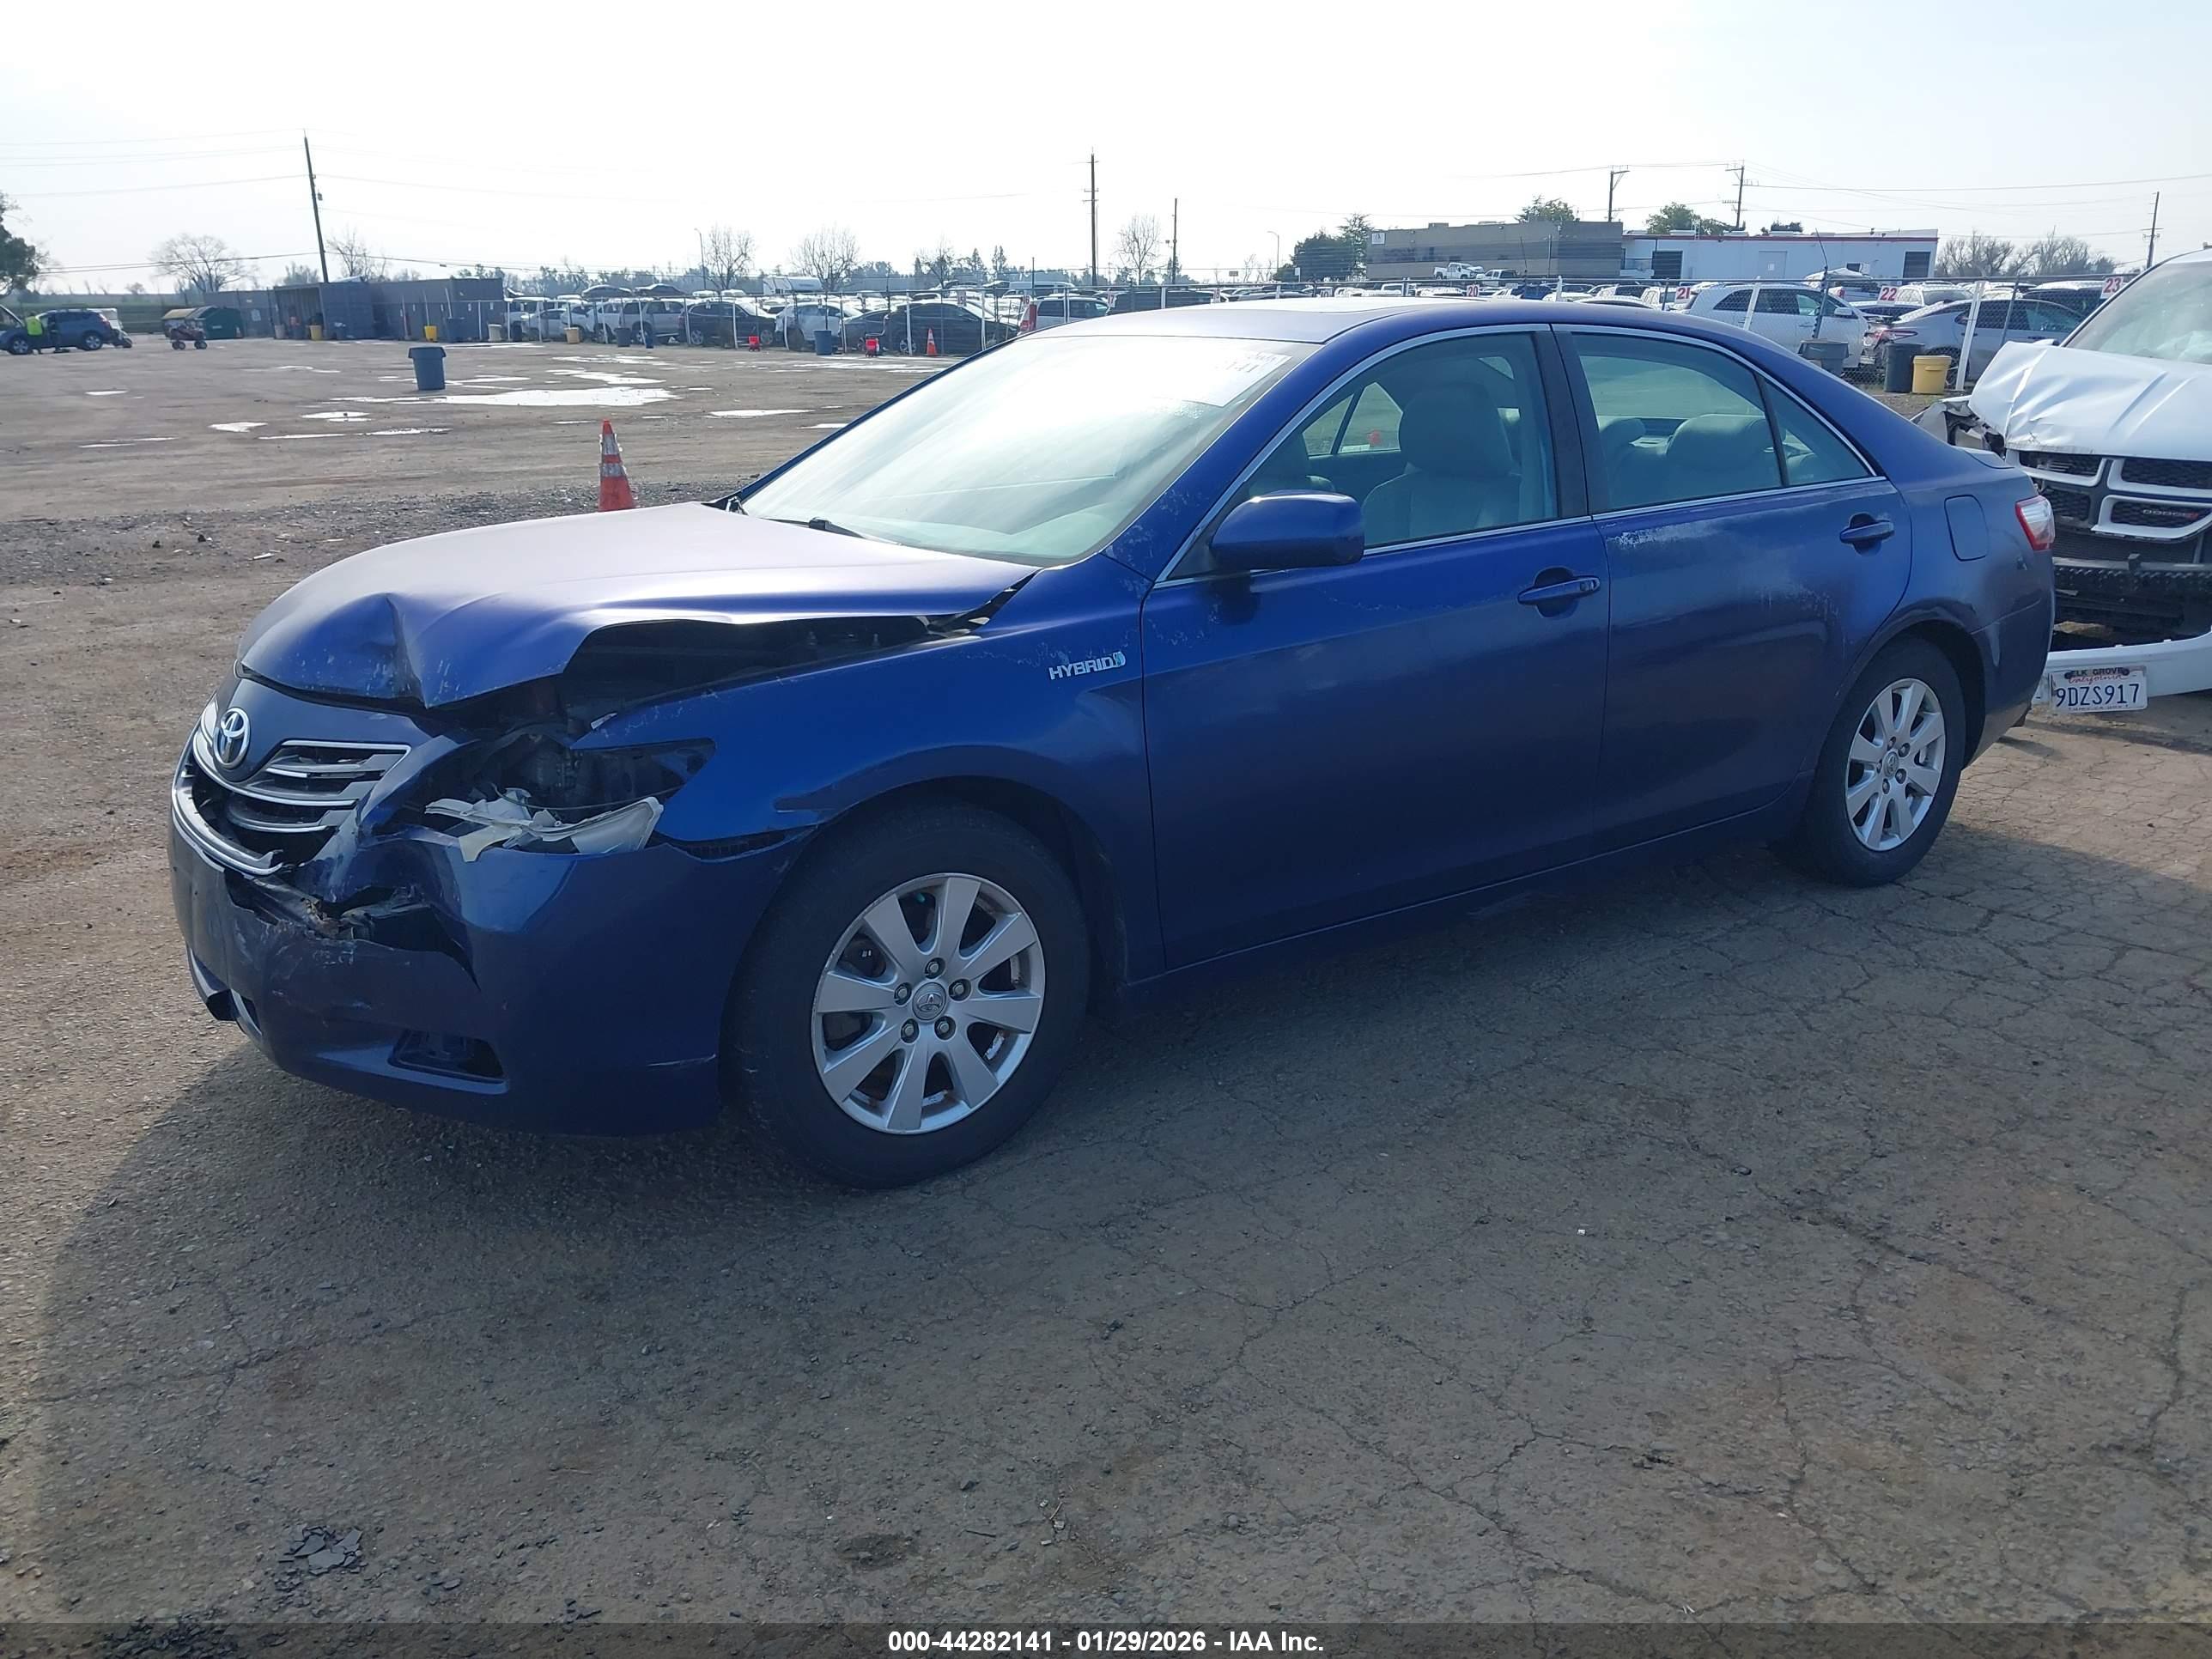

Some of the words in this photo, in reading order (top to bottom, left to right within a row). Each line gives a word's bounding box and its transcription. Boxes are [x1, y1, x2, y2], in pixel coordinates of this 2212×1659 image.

[1468, 286, 1479, 297] 20
[2103, 276, 2122, 293] 23
[1676, 287, 1691, 300] 21
[1880, 287, 1898, 301] 22
[1048, 657, 1116, 680] HYBRID
[2055, 684, 2140, 708] 9DZS917
